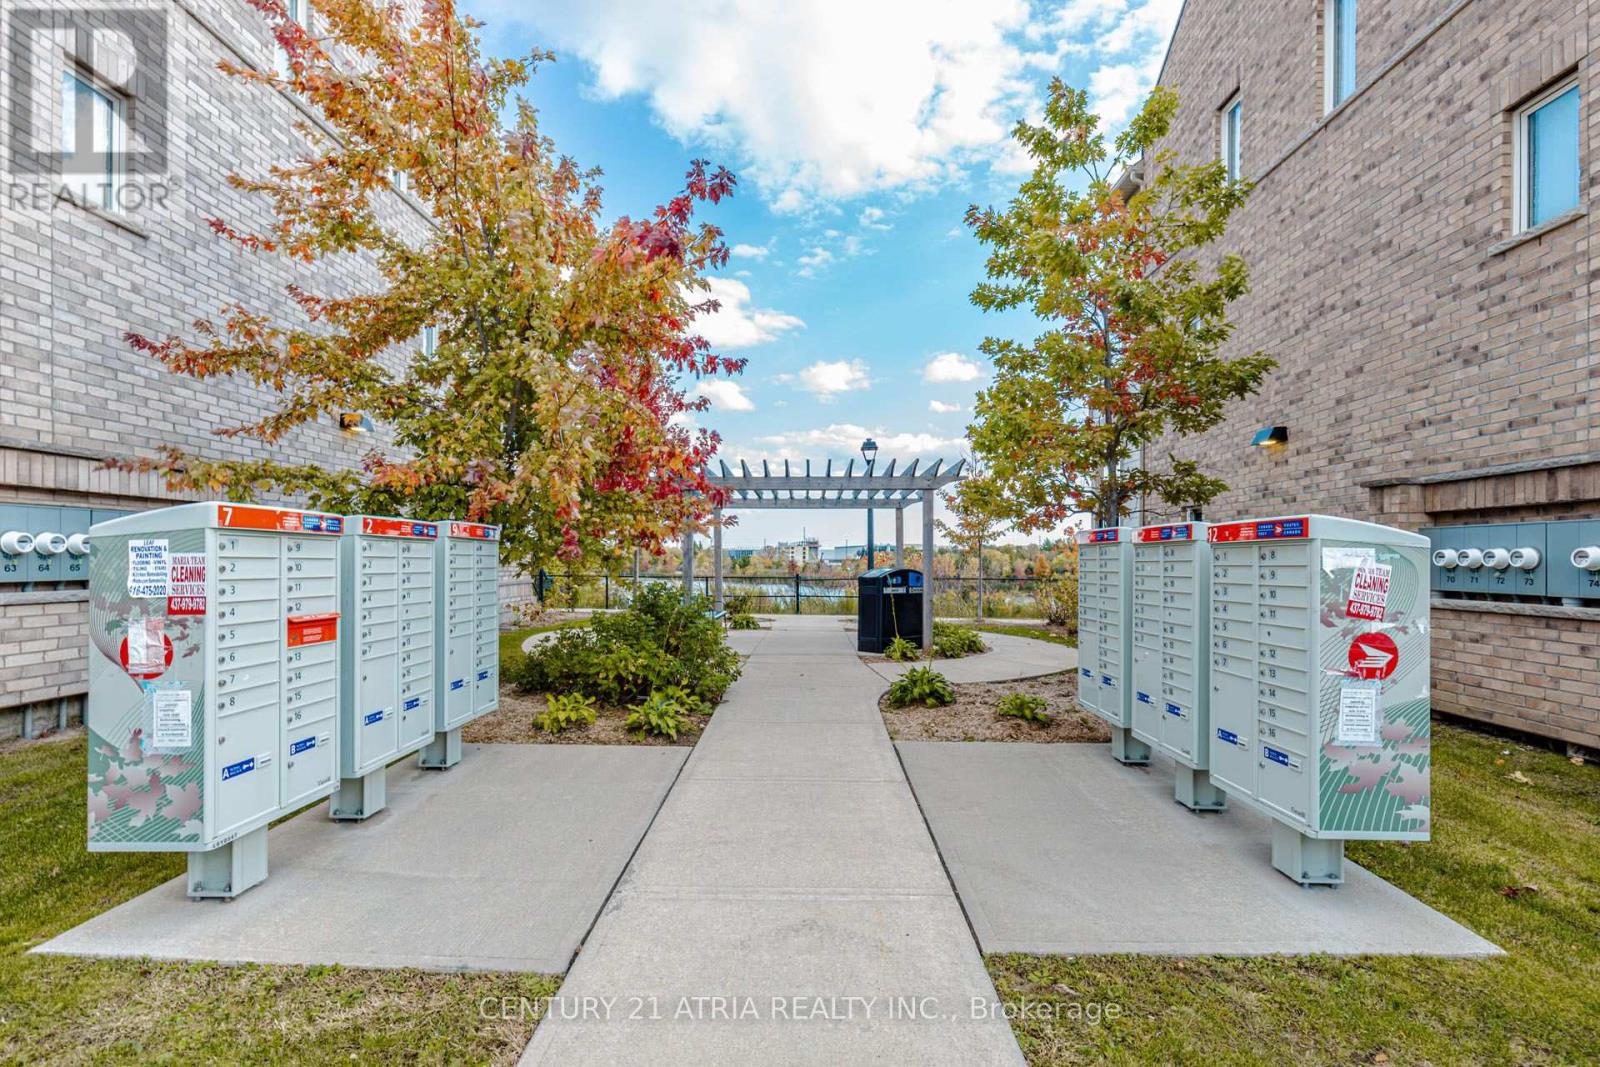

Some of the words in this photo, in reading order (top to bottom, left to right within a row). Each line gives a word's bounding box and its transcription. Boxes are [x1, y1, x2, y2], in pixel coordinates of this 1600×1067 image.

[222, 507, 233, 526] 7
[366, 519, 373, 533] 2
[452, 525, 458, 535] 9
[1208, 528, 1218, 542] 12
[231, 541, 235, 550] 1
[296, 543, 301, 552] 9
[1223, 552, 1227, 560] 1
[1270, 551, 1276, 559] 8
[172, 556, 189, 565] MARIA
[190, 556, 206, 565] TEAM
[4, 564, 17, 572] 63
[38, 564, 50, 572] 64
[69, 564, 80, 572] 65
[230, 563, 236, 572] 2
[295, 563, 302, 572] 10
[171, 566, 206, 583] CLEANING
[1223, 569, 1228, 577] 2
[1270, 571, 1276, 579] 9
[1354, 572, 1389, 594] CLEANING
[1524, 578, 1534, 586] 73
[171, 584, 206, 595] SERVICES
[230, 586, 236, 594] 3
[294, 583, 301, 591] 11
[1223, 587, 1228, 595] 3
[1269, 590, 1276, 599] 10
[1353, 590, 1386, 605] SERVICES
[295, 602, 302, 610] 12
[229, 608, 235, 616] 4
[1270, 610, 1276, 618] 11
[1222, 623, 1227, 631] 5
[230, 630, 235, 639] 5
[1222, 640, 1227, 648] 6
[229, 652, 235, 661] 6
[294, 652, 302, 660] 13
[1269, 649, 1276, 658] 12
[1222, 658, 1227, 666] 7
[294, 672, 302, 680] 14
[1269, 669, 1276, 678] 13
[230, 674, 235, 683] 7
[294, 692, 302, 700] 15
[1269, 689, 1276, 697] 14
[229, 697, 235, 706] 8
[294, 712, 302, 720] 16
[1269, 708, 1276, 717] 15
[1268, 728, 1276, 737] 16
[290, 744, 296, 755] B
[222, 768, 230, 779] A
